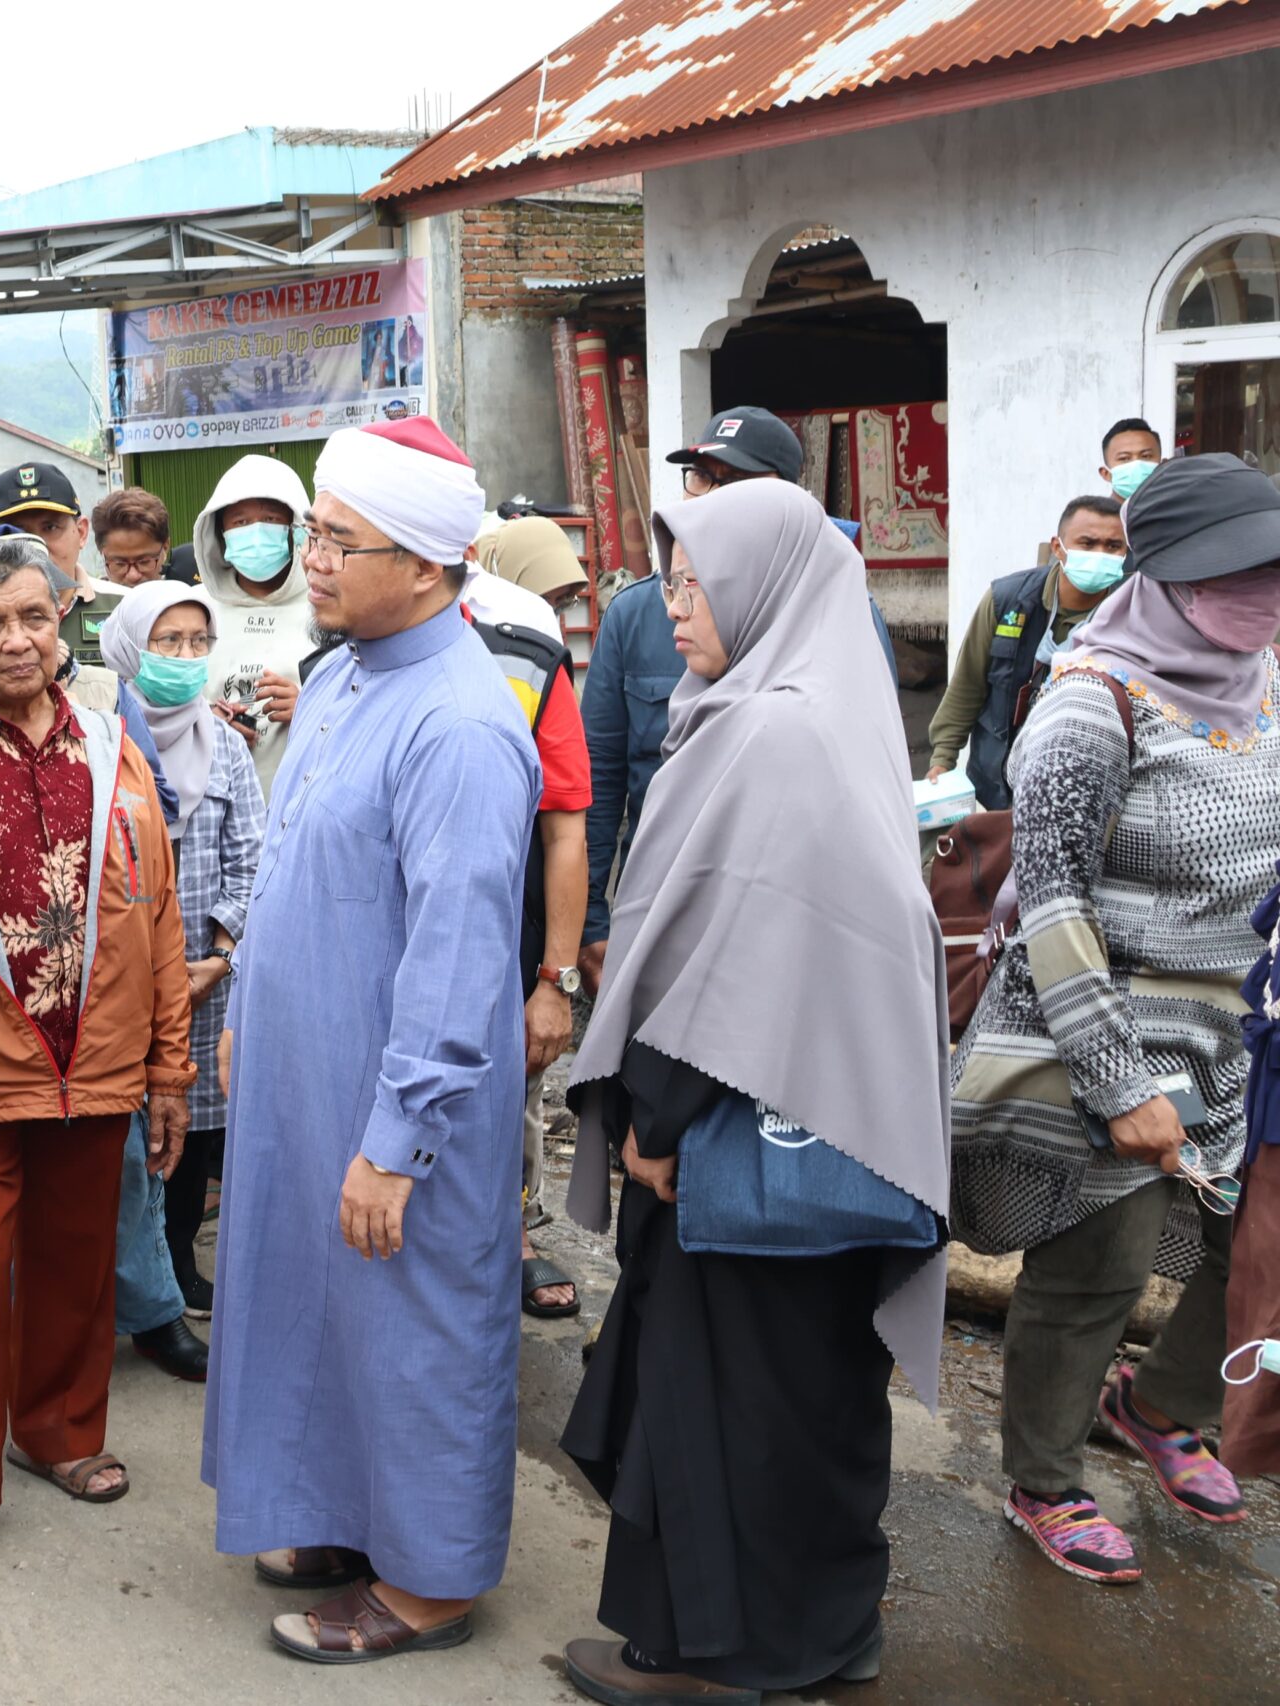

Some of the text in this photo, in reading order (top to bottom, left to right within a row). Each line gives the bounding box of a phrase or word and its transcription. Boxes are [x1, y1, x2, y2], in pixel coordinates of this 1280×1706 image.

[147, 269, 382, 341] KAKEK GEMEEZZZZ
[166, 321, 362, 369] Rental PS & Top Up Game
[153, 422, 185, 441] OVO
[201, 419, 240, 437] gopay
[243, 416, 279, 432] BRIZZI
[247, 616, 276, 627] G.R.V
[243, 626, 276, 635] COMPANY
[240, 663, 263, 674] WFP
